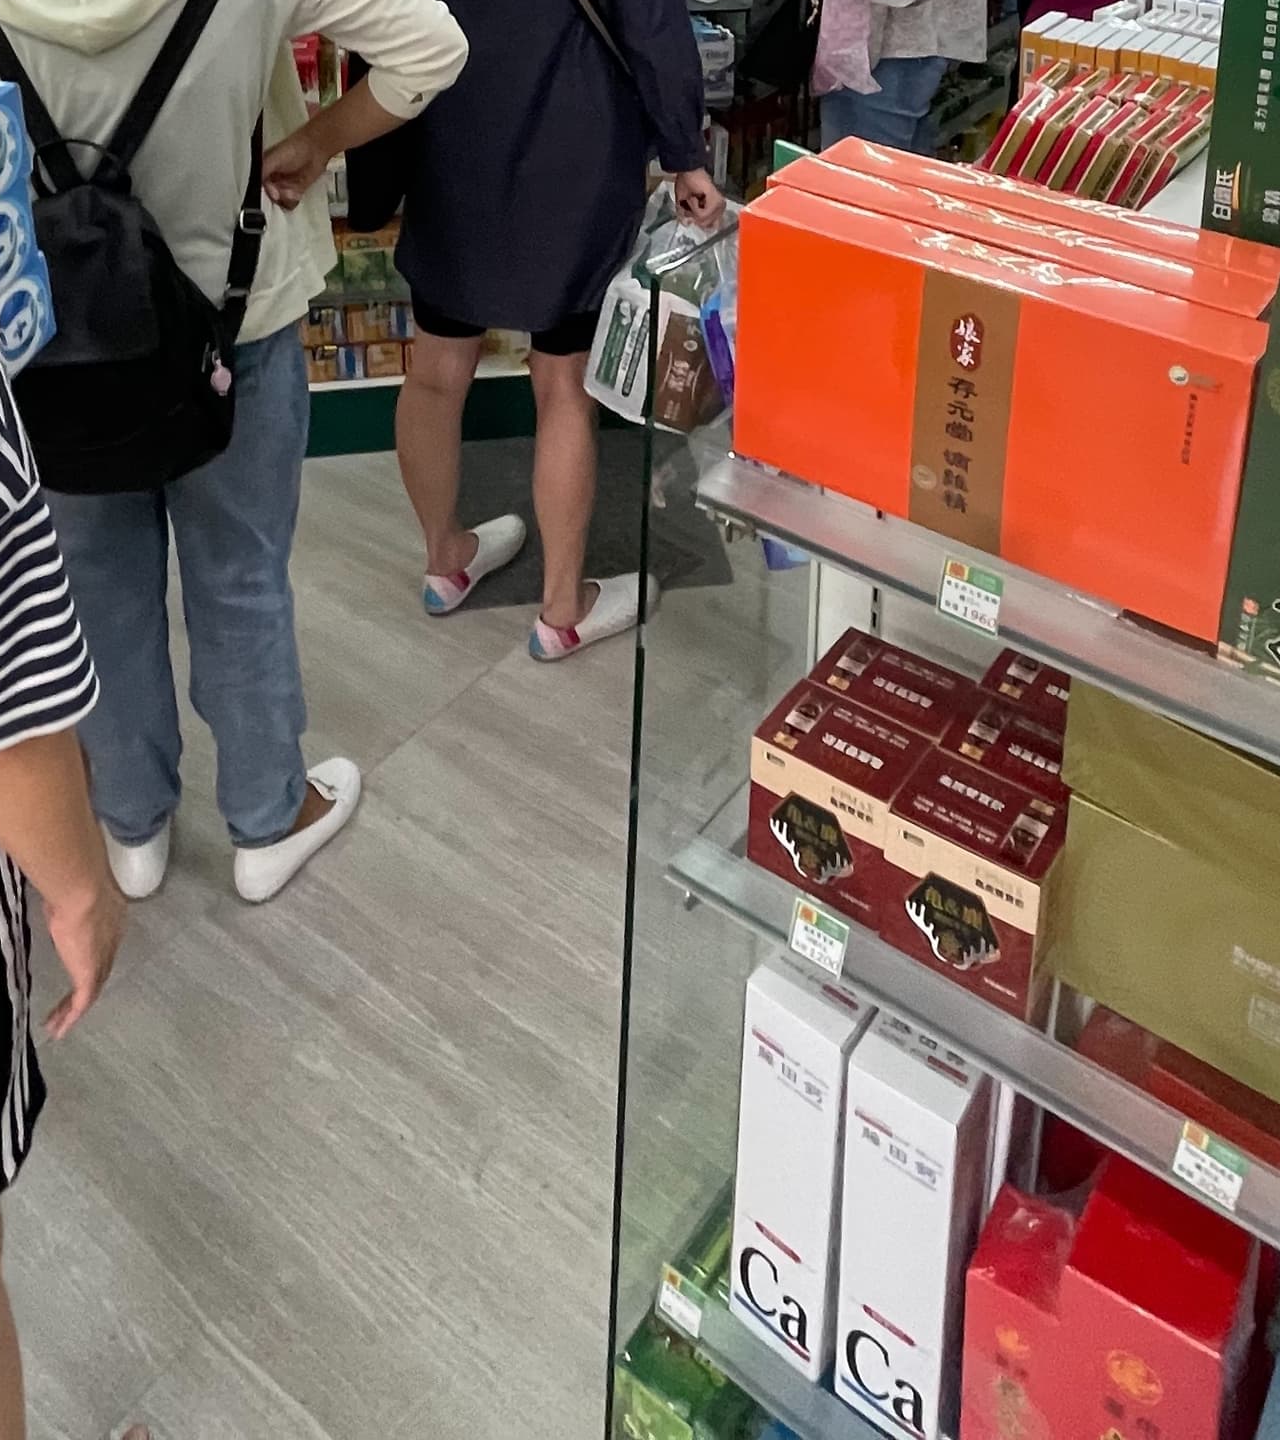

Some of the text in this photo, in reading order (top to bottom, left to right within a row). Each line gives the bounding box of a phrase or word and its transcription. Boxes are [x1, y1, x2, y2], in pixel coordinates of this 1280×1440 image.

[963, 606, 997, 629] 1960
[738, 1246, 812, 1355] Ca
[845, 1328, 927, 1439] Ca
